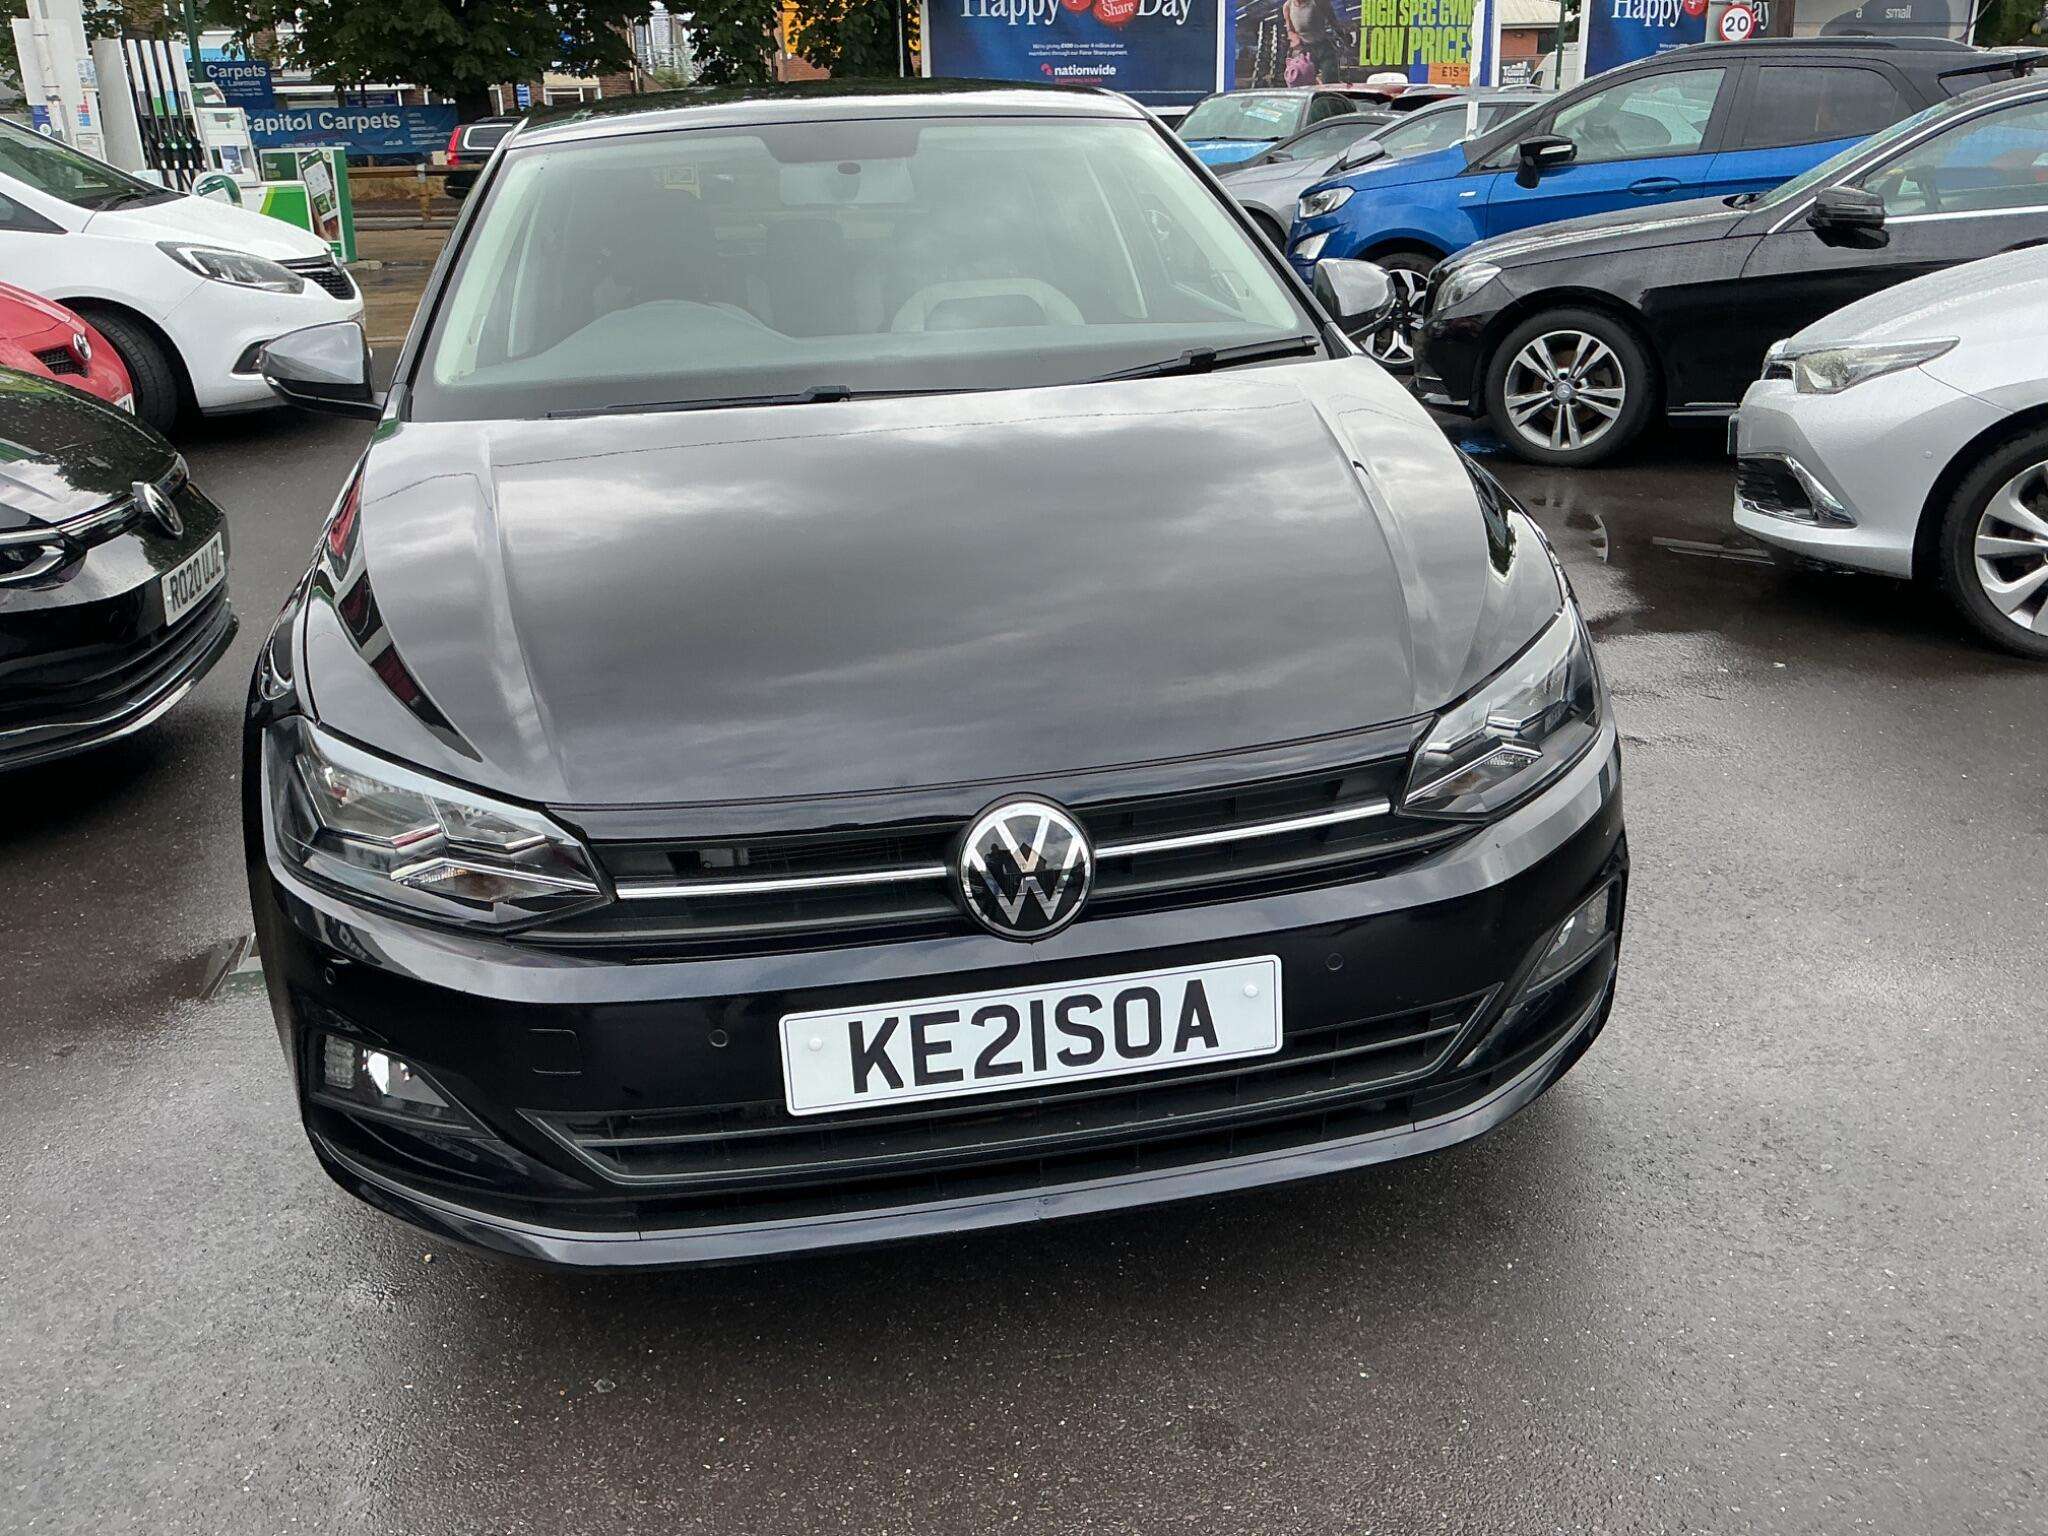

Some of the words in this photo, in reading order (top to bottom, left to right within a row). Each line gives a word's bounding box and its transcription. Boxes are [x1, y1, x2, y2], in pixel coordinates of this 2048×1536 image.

[1103, 1, 1134, 18] Share
[1360, 0, 1397, 26] HIGH
[1399, 0, 1437, 26] SPEC
[1439, 0, 1474, 26] GYM
[1610, 0, 1683, 28] Happy
[1752, 0, 1770, 31] ay
[1855, 8, 1863, 19] a
[1885, 5, 1911, 19] small
[1725, 16, 1749, 33] 20
[1359, 27, 1404, 66] LOW
[206, 64, 267, 80] Carpets
[1054, 64, 1117, 76] nationwide
[318, 111, 401, 134] Carpets
